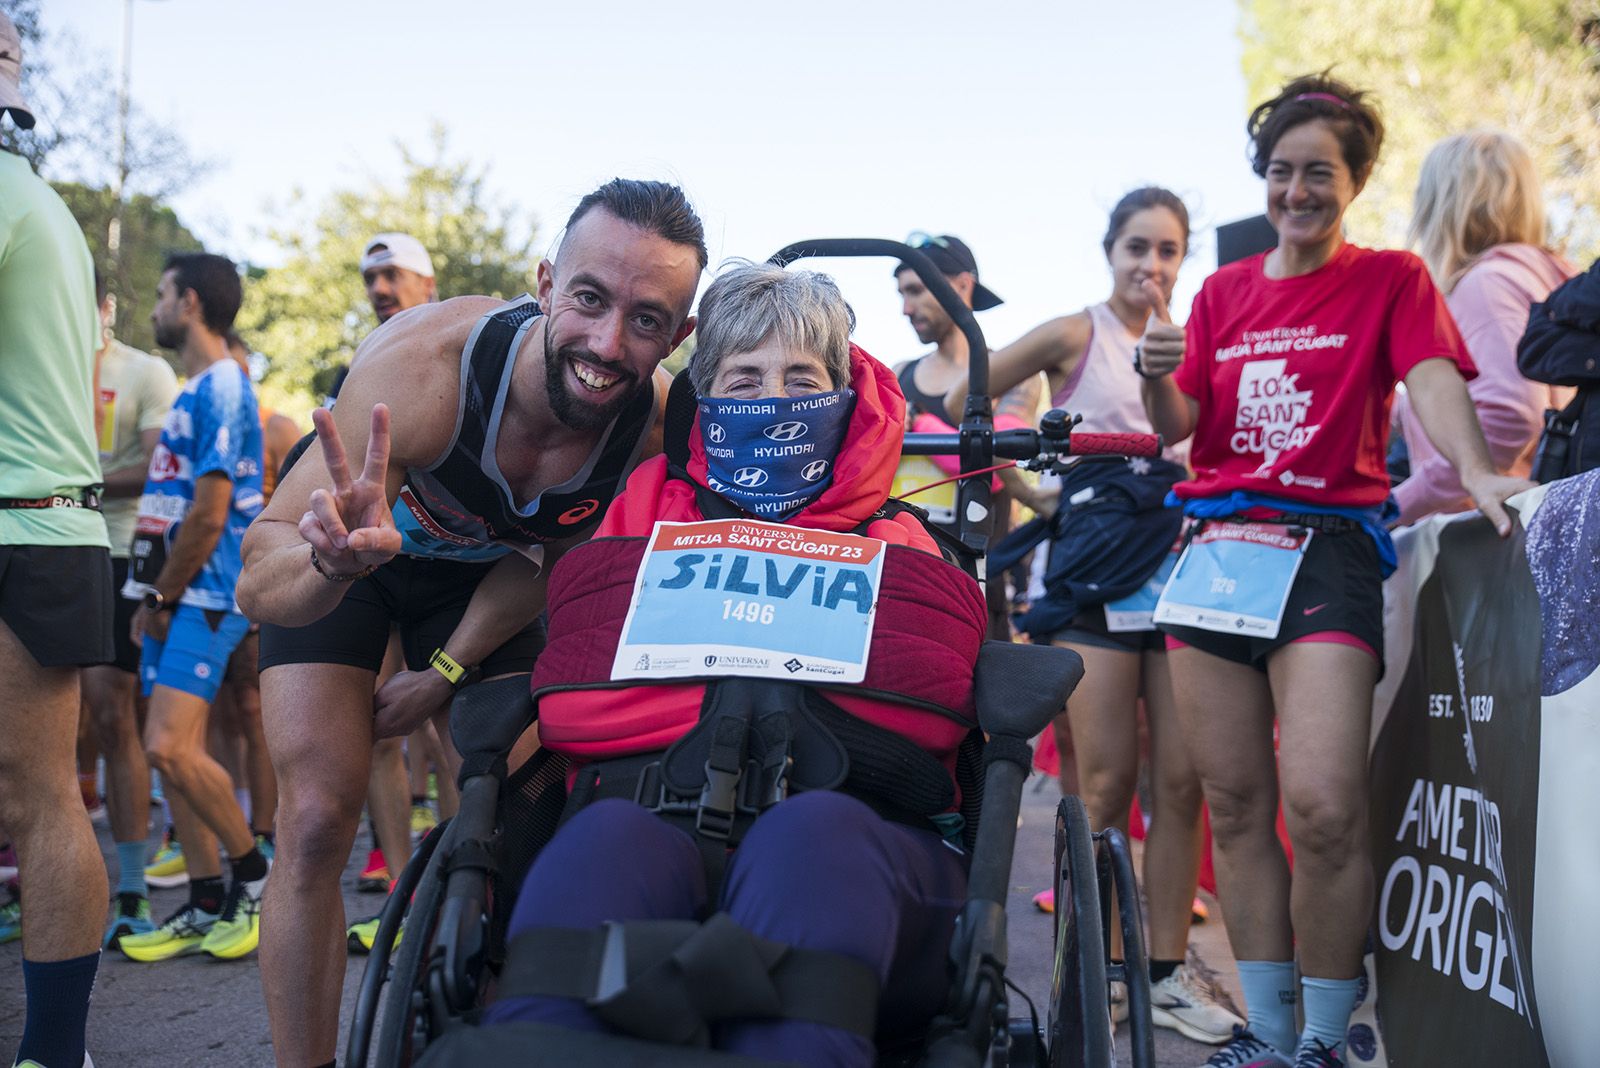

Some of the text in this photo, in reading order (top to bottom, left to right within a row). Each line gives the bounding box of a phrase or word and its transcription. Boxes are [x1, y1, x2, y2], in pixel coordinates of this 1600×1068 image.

[1243, 324, 1317, 342] UNIVERSAE
[1253, 340, 1293, 355] SANT
[1293, 334, 1348, 351] CUGAT
[1250, 373, 1300, 399] 10K
[718, 405, 776, 415] HYUNDAI
[791, 394, 840, 412] HYUNDAI
[1238, 400, 1313, 427] SANT
[1230, 424, 1321, 454] CUGAT
[754, 443, 815, 458] HYUNDAI
[755, 496, 810, 513] HYUND
[731, 525, 805, 541] UNIVERSAE
[673, 533, 863, 559] MITJA SANT CUGAT 23
[722, 599, 775, 625] 1496
[719, 656, 770, 666] UNIVERSAE
[1428, 693, 1494, 722] EST. 1830
[1379, 855, 1534, 1030] ORIGE
